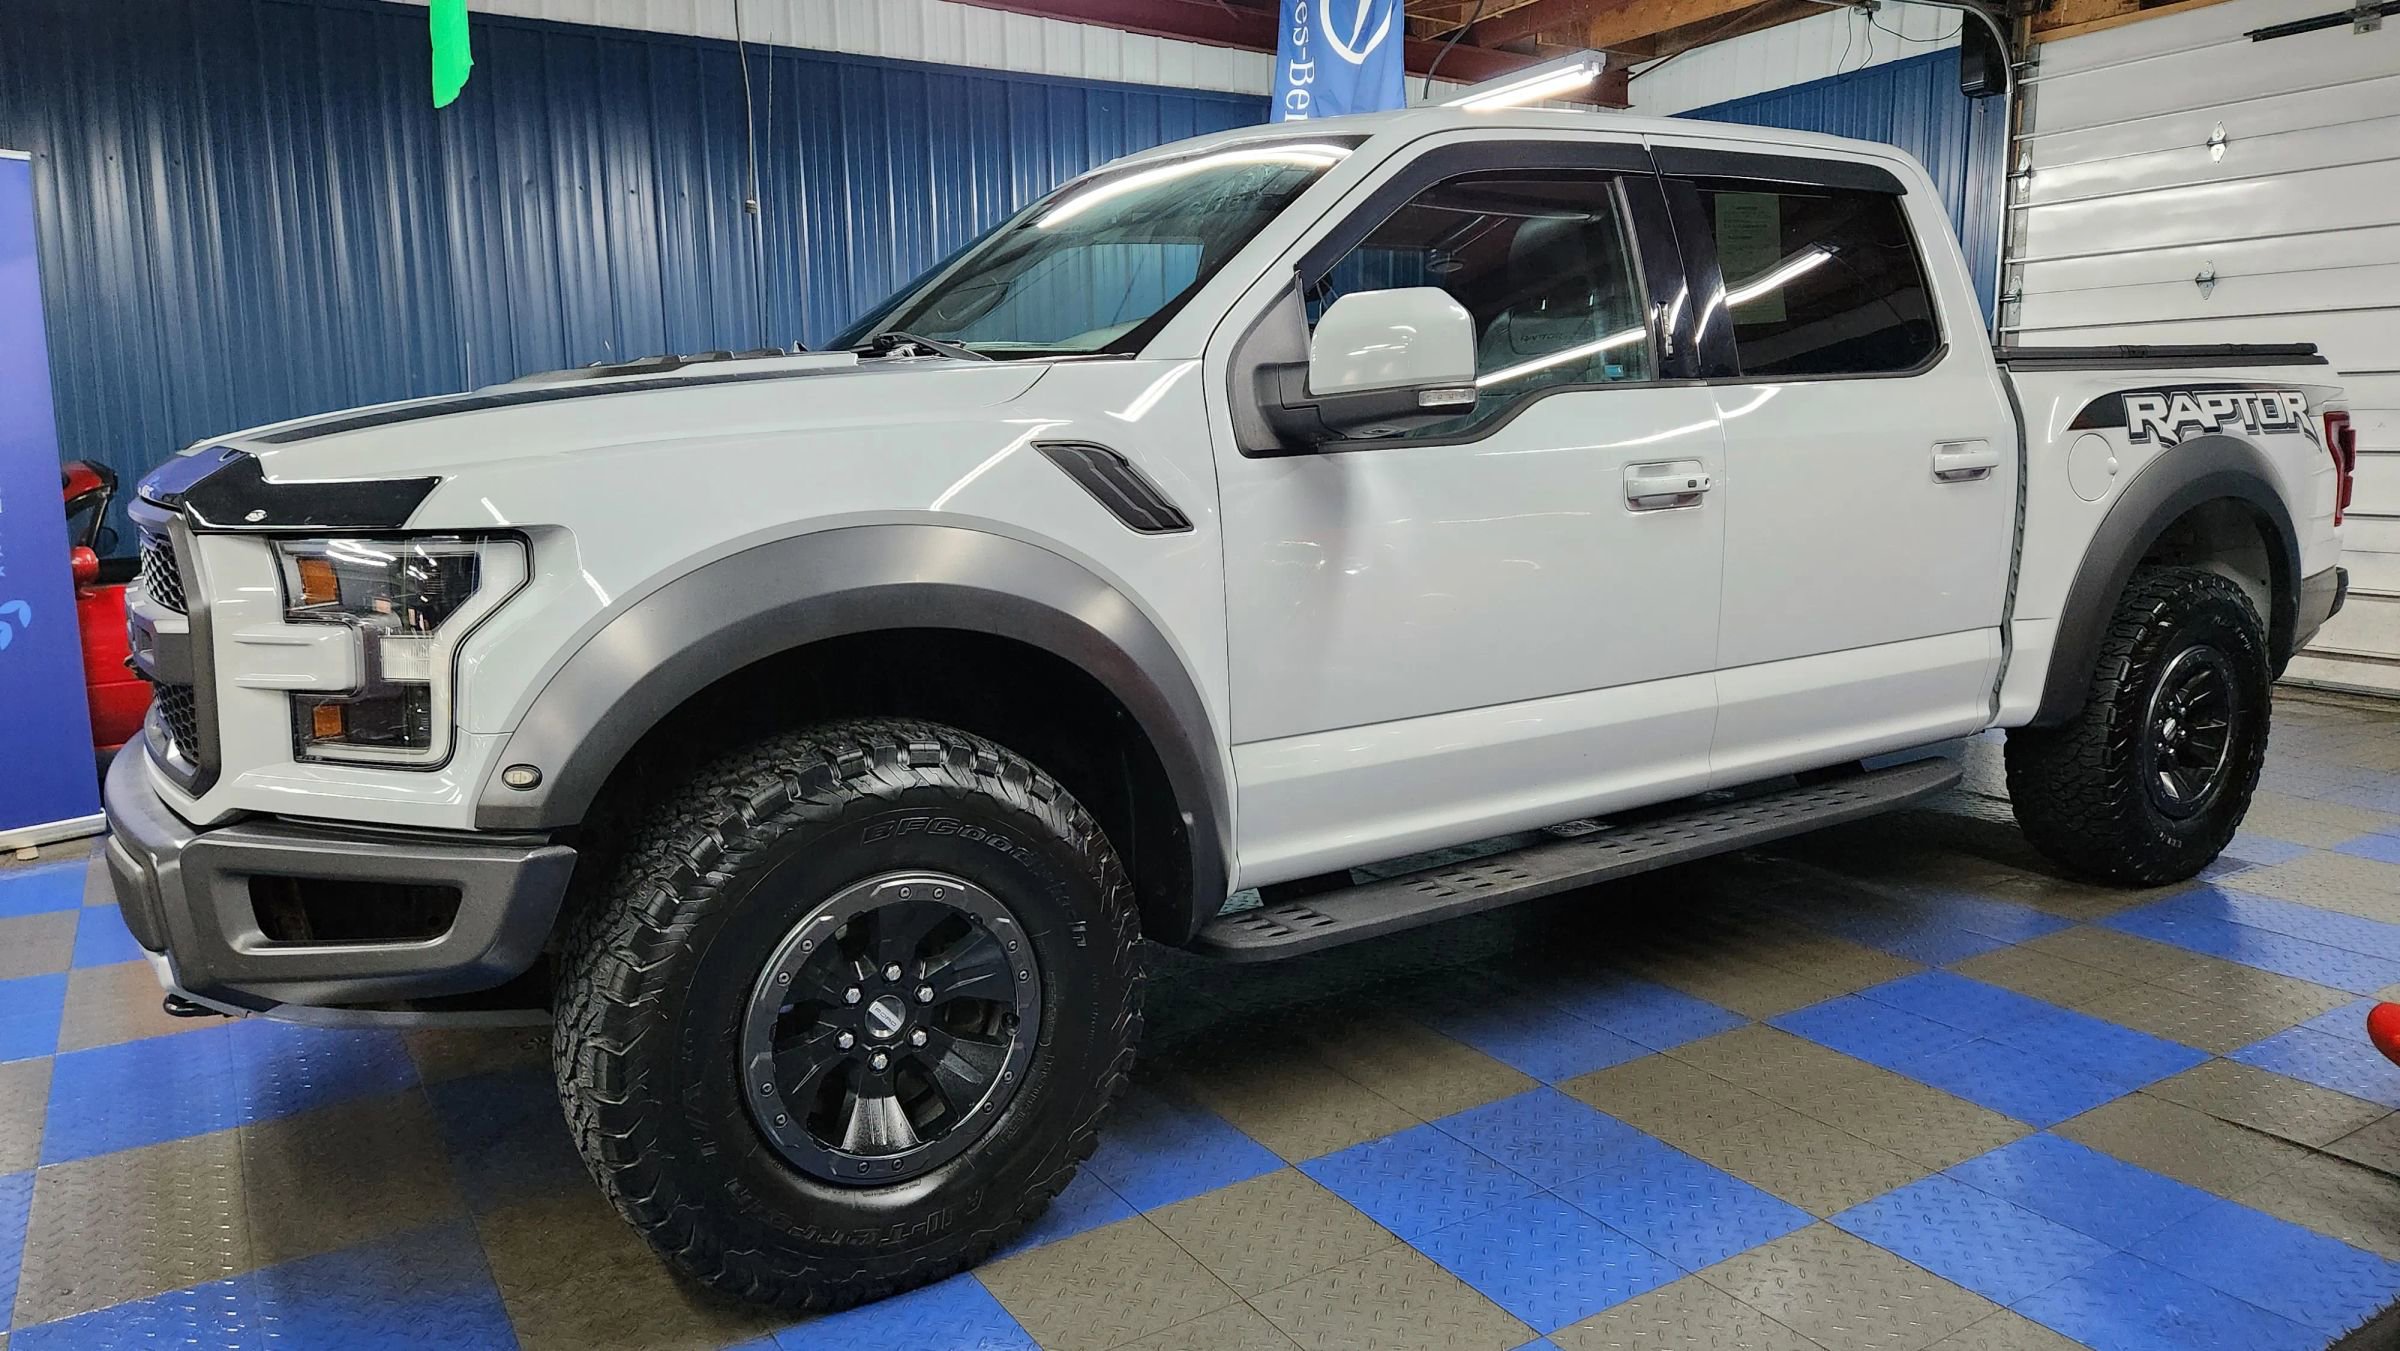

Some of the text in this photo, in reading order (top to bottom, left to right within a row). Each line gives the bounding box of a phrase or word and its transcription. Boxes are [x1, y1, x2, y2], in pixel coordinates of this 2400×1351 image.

[1285, 0, 1316, 122] es-Be
[2121, 389, 2322, 452] RAPTOR
[874, 1007, 897, 1027] FORD
